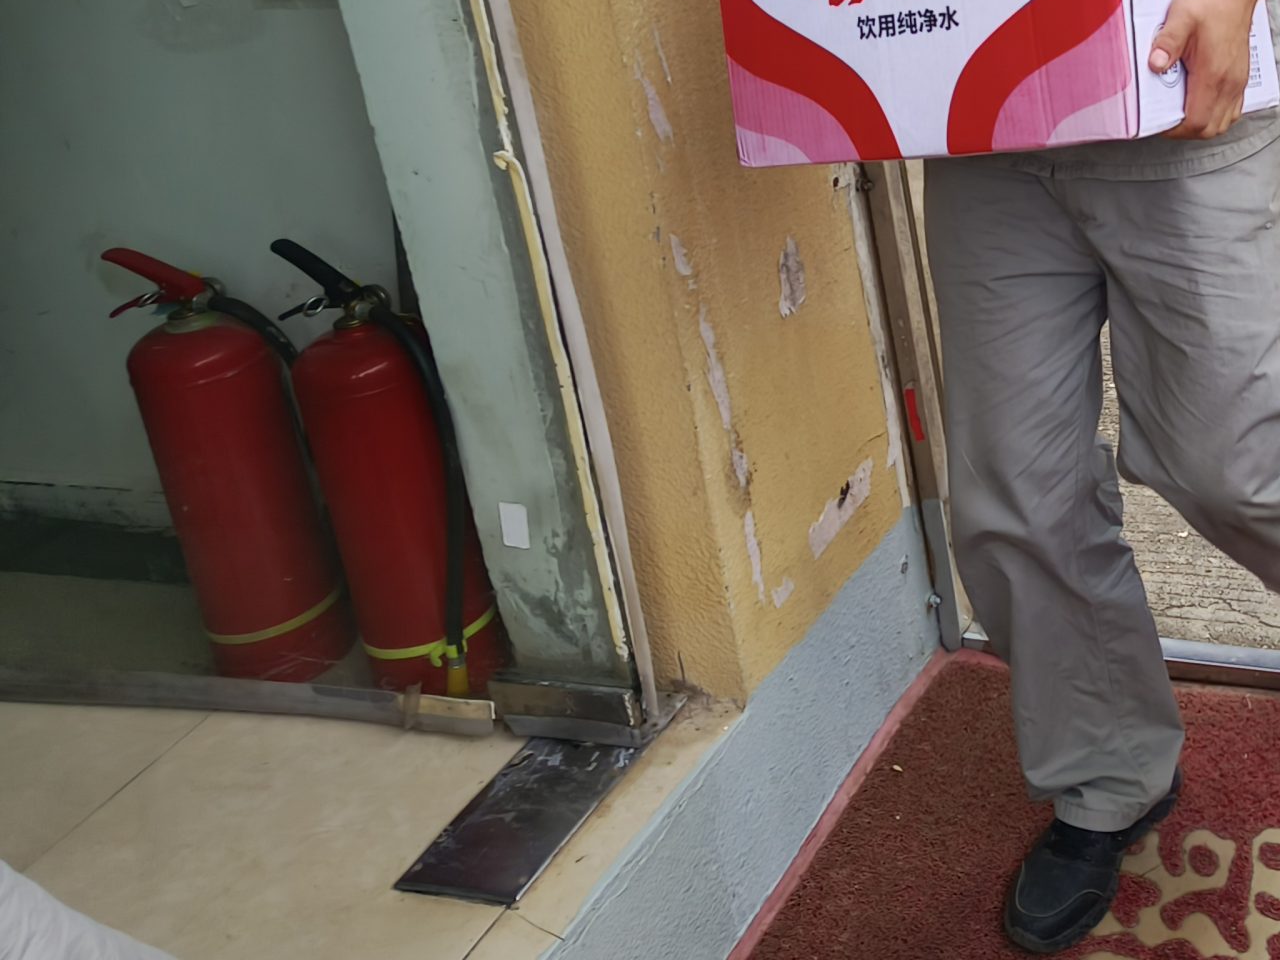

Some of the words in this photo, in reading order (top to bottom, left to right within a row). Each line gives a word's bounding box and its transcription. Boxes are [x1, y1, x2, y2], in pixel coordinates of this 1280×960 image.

[857, 5, 959, 41] 饮用纯净水
